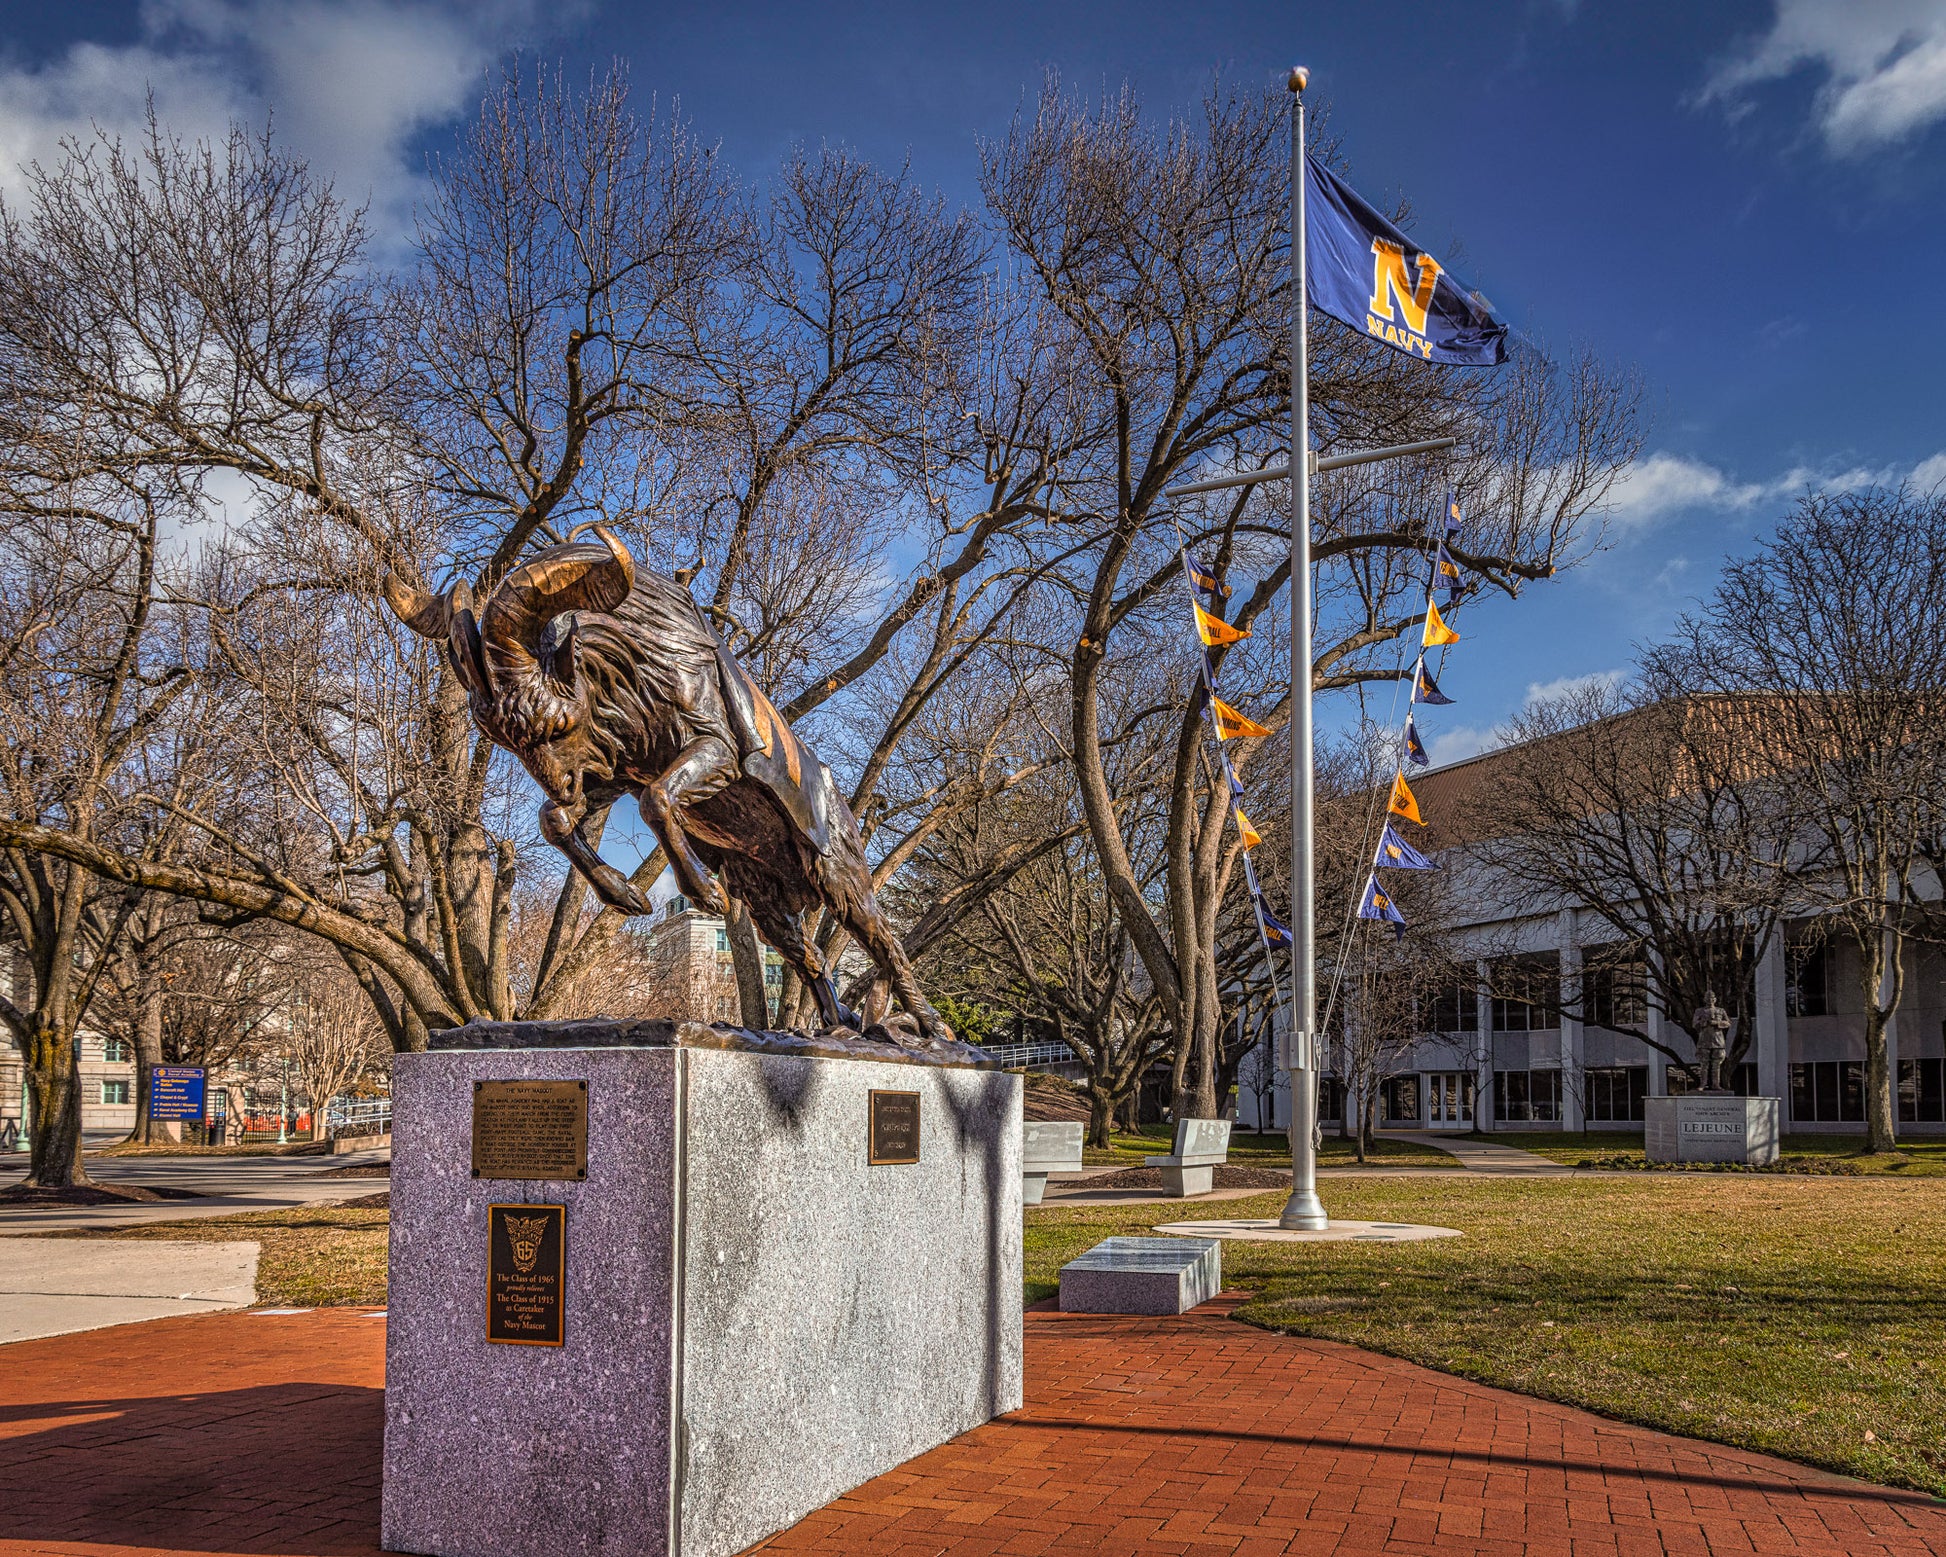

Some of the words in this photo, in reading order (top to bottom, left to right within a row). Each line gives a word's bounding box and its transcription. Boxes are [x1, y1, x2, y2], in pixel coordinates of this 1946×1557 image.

[1370, 235, 1445, 337] N
[1367, 314, 1433, 359] NAVY
[1684, 1123, 1742, 1133] LEJEUNE
[517, 1241, 534, 1260] 65
[497, 1273, 509, 1282] The
[511, 1274, 528, 1282] Class
[529, 1275, 537, 1283] of
[539, 1275, 554, 1284] 1965
[506, 1285, 526, 1293] proudly
[496, 1294, 509, 1302] The
[511, 1294, 528, 1302] Class
[529, 1295, 537, 1303] of
[538, 1296, 554, 1304] 1915
[513, 1304, 544, 1313] Caretaker
[504, 1320, 520, 1330] Navy
[522, 1321, 545, 1330] Mascot
